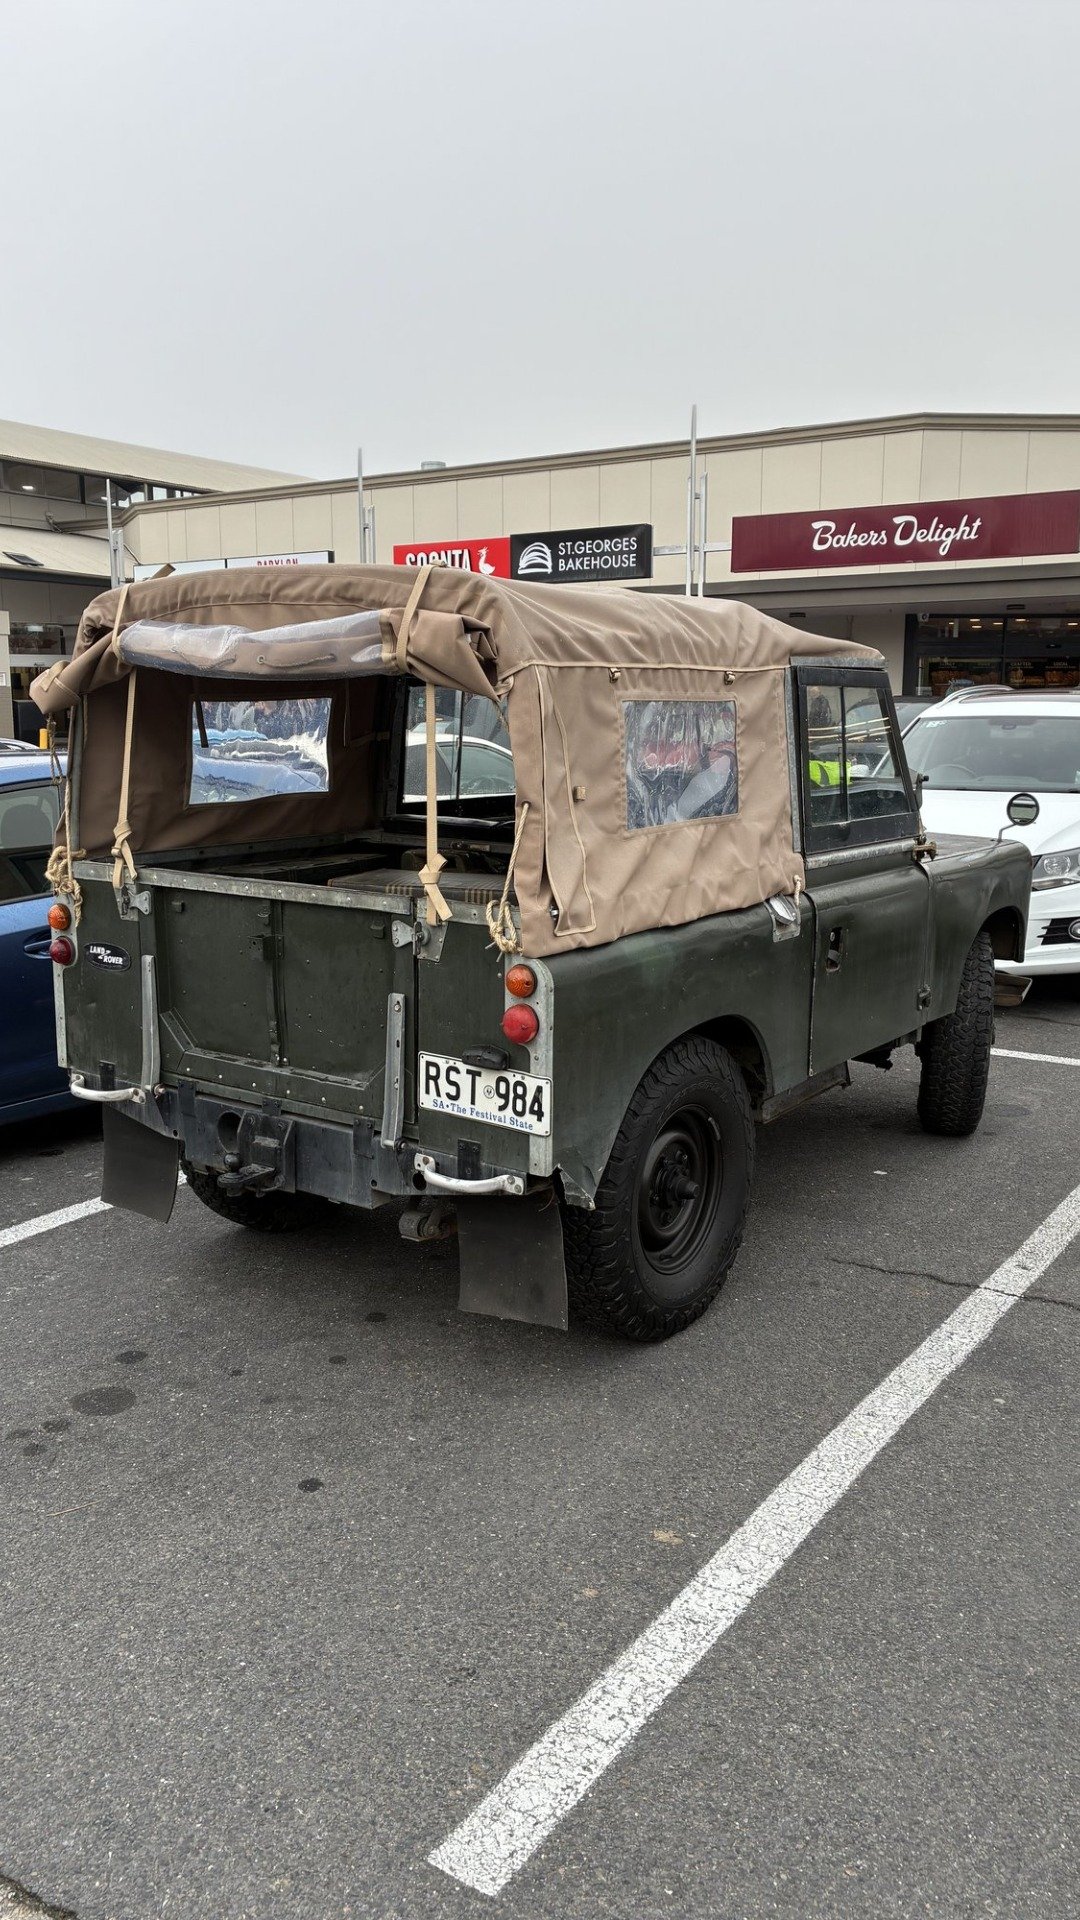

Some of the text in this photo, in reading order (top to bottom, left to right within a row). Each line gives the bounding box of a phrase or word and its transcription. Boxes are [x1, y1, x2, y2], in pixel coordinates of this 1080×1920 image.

[811, 514, 982, 556] Bakers Delight
[558, 537, 638, 556] ST.GEORGES
[558, 553, 637, 572] BAKEHOUSE
[90, 945, 105, 954] LAND
[103, 955, 123, 965] ROVER
[425, 1060, 544, 1122] RST 984
[469, 1107, 507, 1124] Festival
[509, 1116, 534, 1131] State
